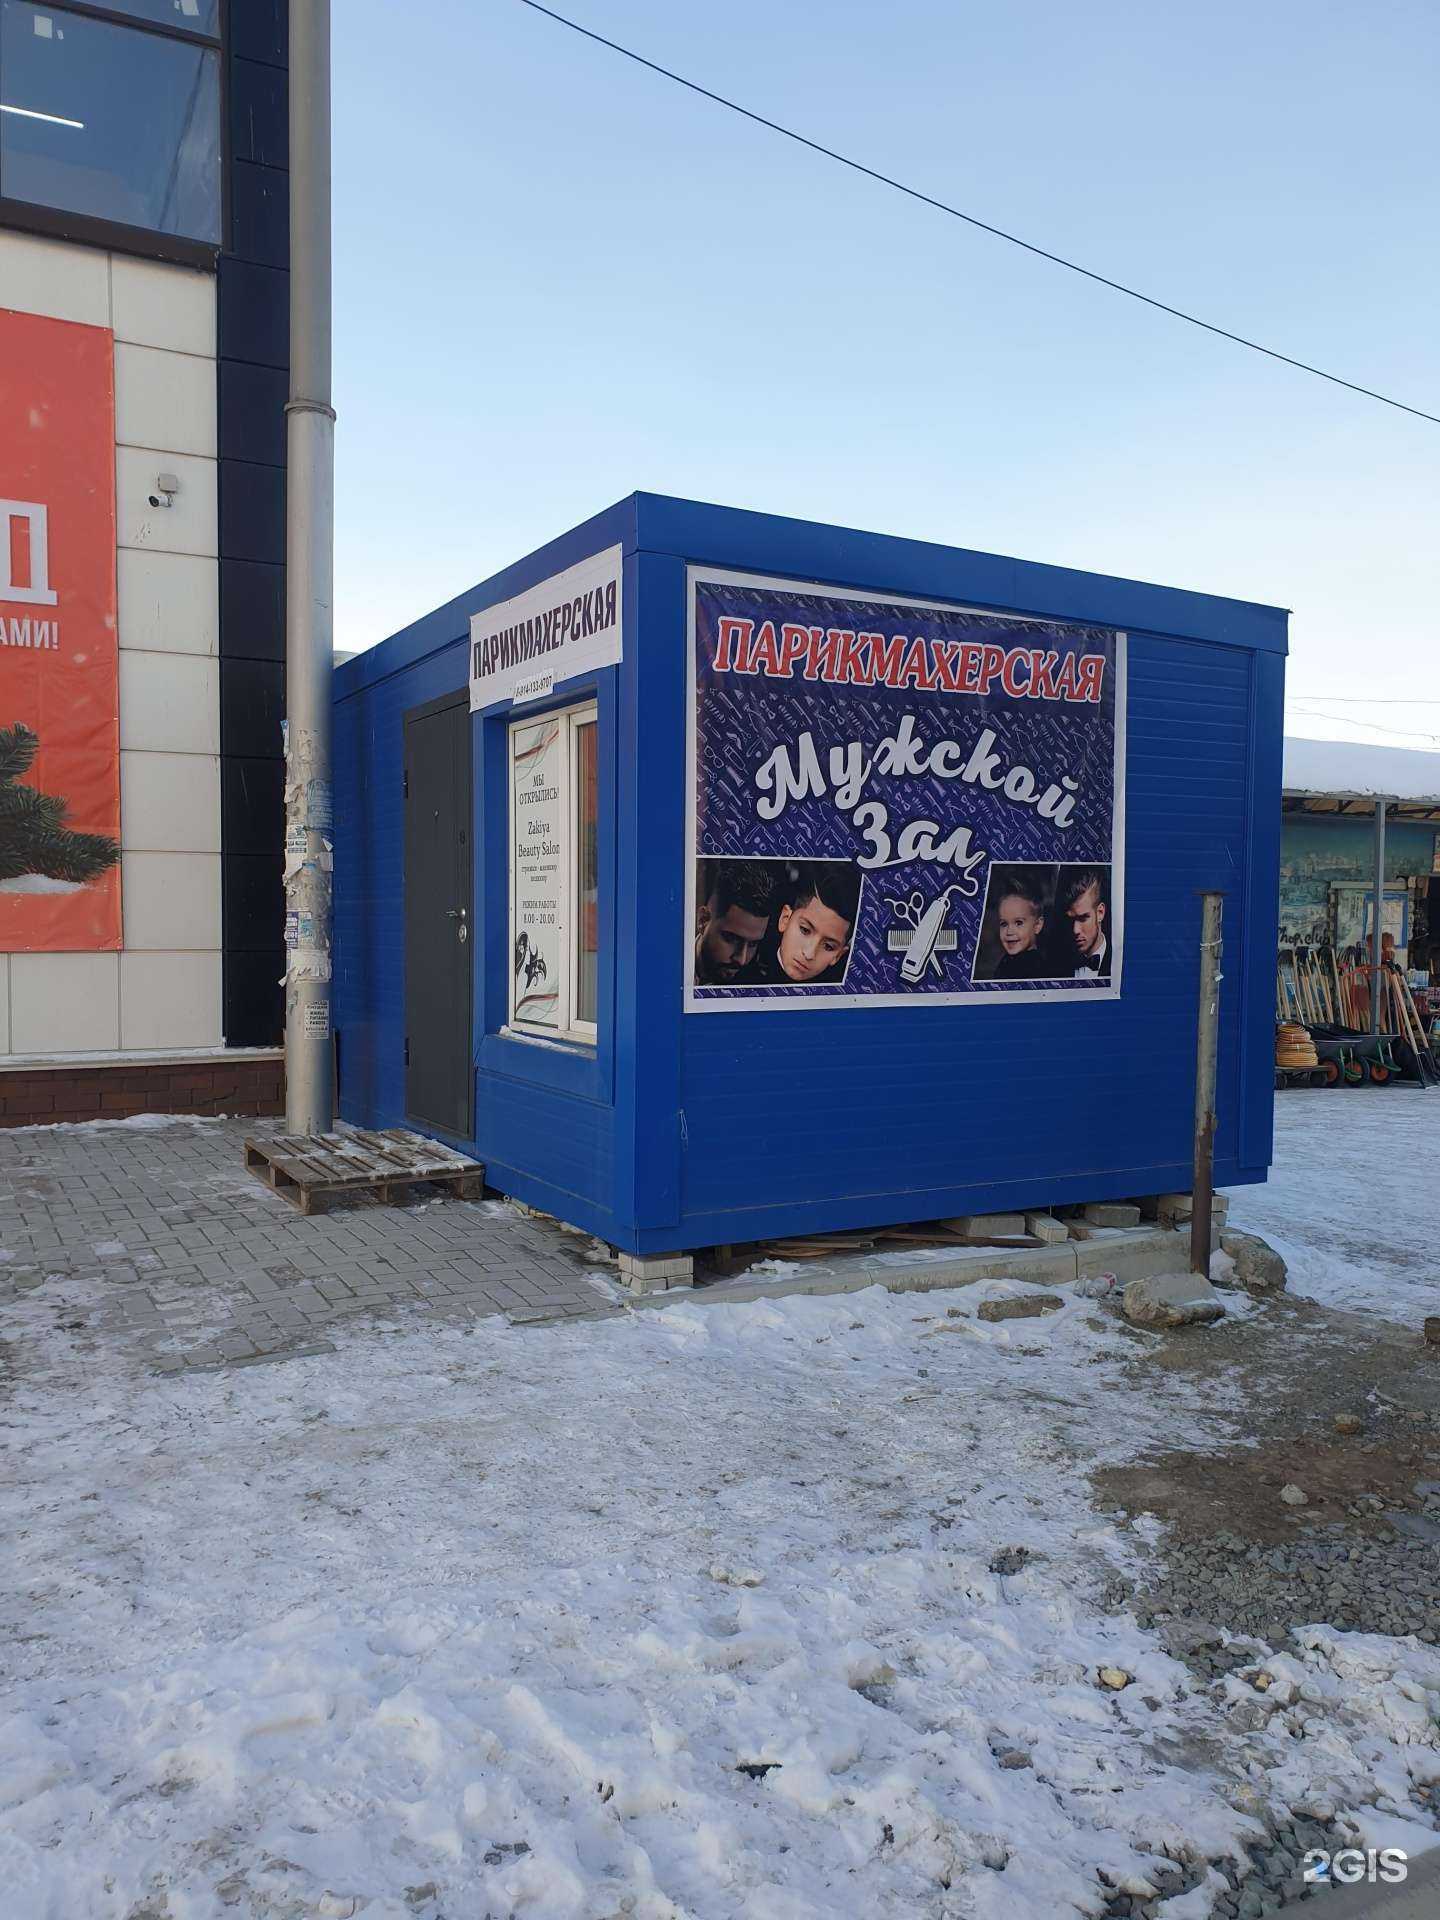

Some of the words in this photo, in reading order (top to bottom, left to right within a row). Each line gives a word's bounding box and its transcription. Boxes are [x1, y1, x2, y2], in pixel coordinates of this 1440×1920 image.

[473, 579, 617, 680] ПАРИКМАХЕРСКАЯ
[712, 615, 1106, 703] ПАРИКМАХЕРСКАЯ
[532, 773, 545, 788] МЫ
[755, 714, 1079, 828] Мужской
[518, 843, 540, 861] Beauty
[541, 840, 560, 856] Salon
[527, 819, 550, 838] Zakiya
[852, 801, 986, 869] Зал
